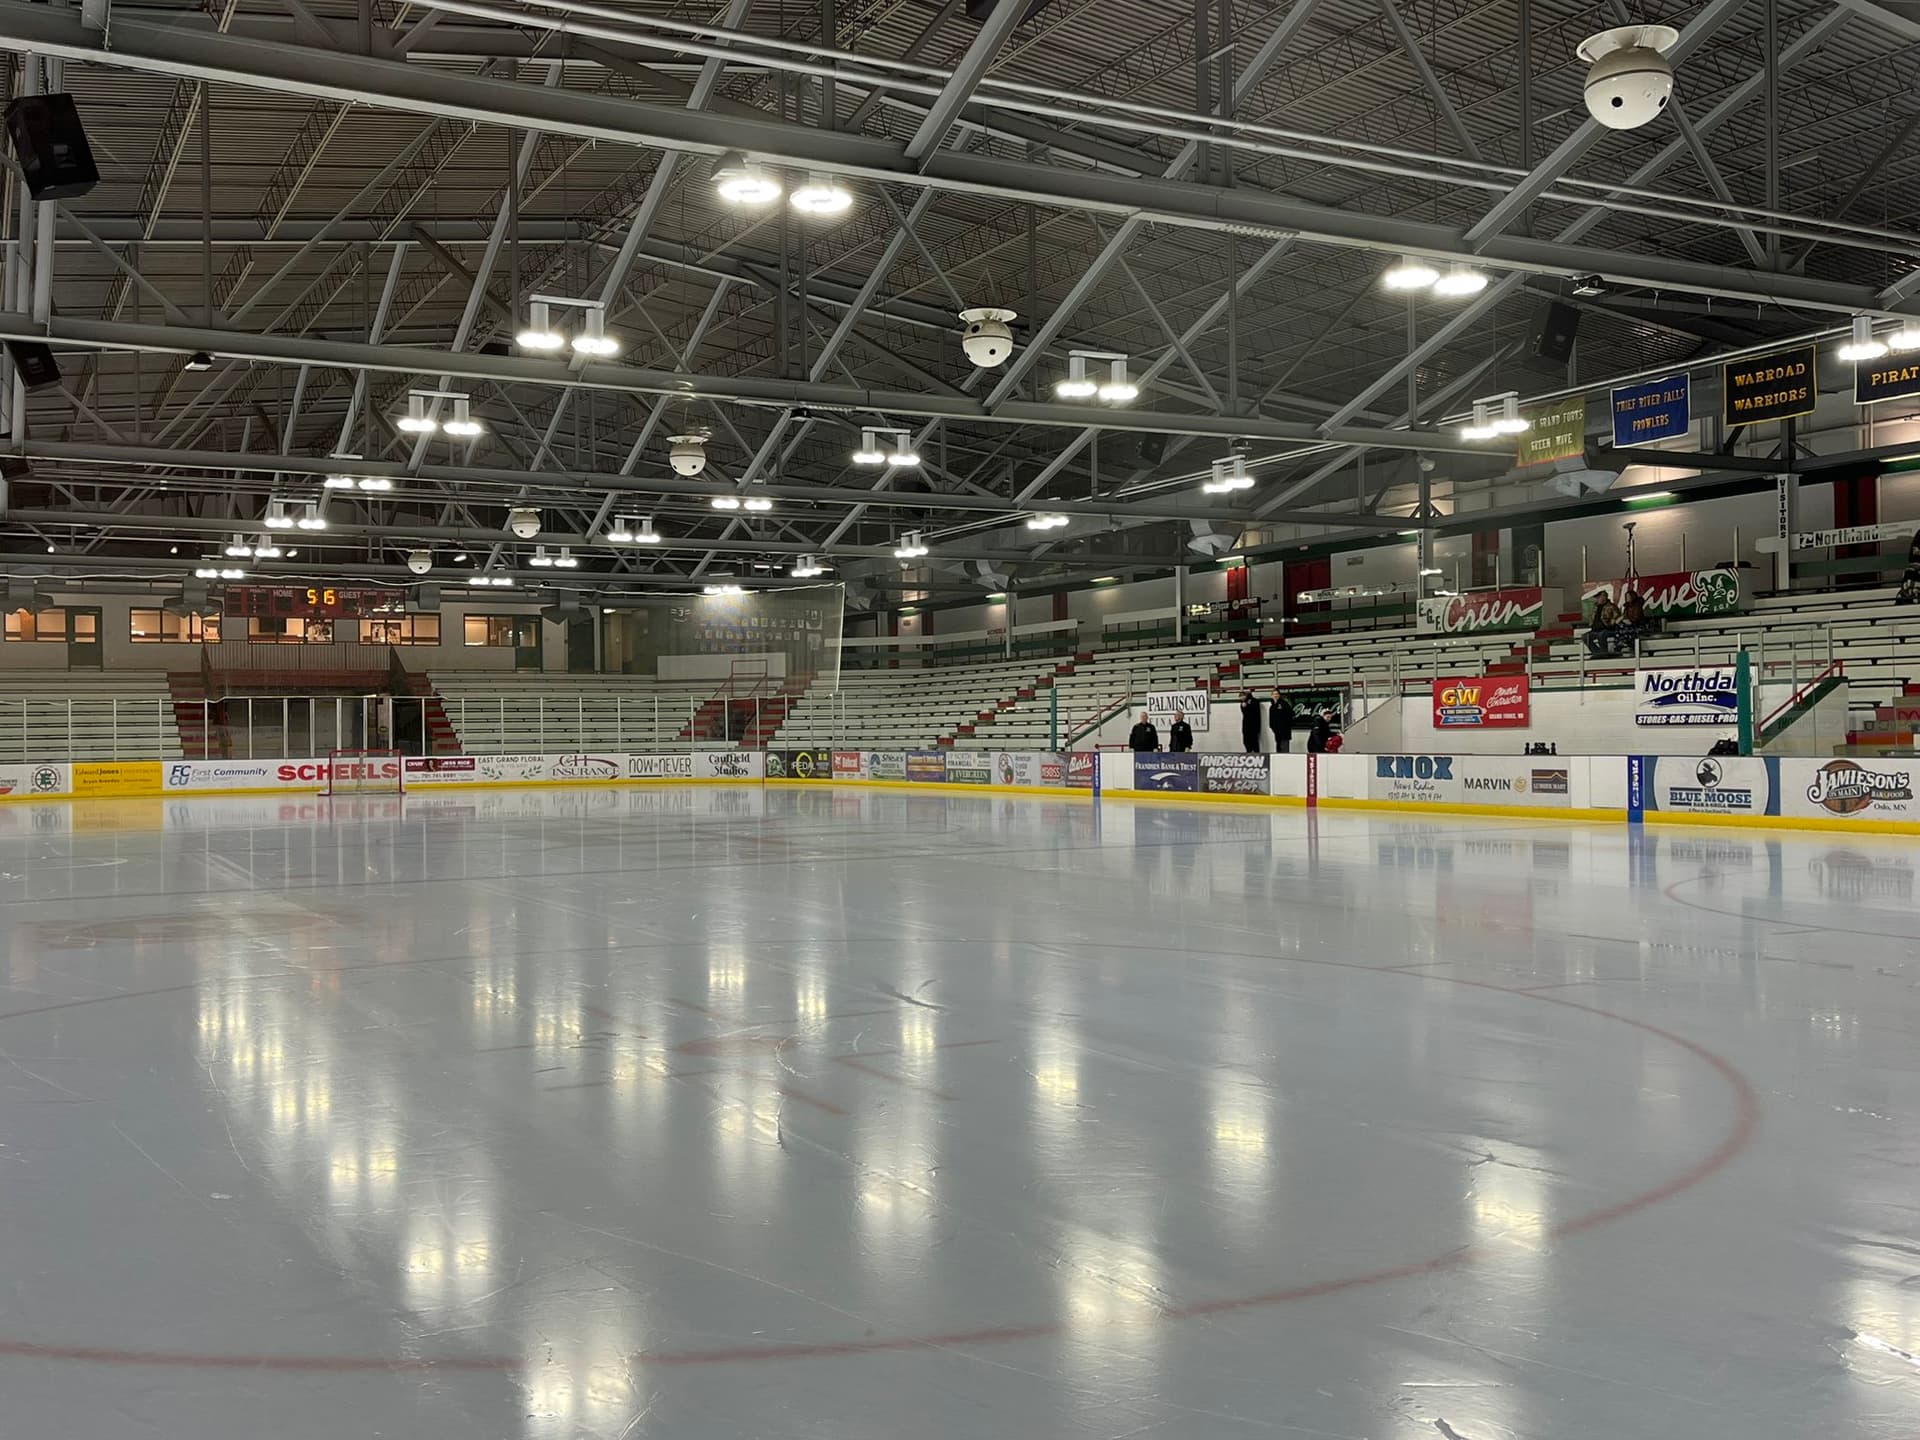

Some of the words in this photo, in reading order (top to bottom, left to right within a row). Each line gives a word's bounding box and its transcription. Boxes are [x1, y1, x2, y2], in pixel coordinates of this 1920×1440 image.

[1734, 363, 1806, 387] WARROAD
[1616, 399, 1636, 412] THIEF
[1638, 394, 1661, 408] RIVER
[1663, 388, 1685, 403] FALLS
[1734, 387, 1807, 411] WARRIORS
[1632, 414, 1669, 431] PROWLERS
[1779, 480, 1787, 539] VISITORS
[272, 590, 293, 598] HOME
[1645, 671, 1738, 692] Northdal
[1440, 687, 1481, 706] GW
[1677, 693, 1694, 703] Oil
[1696, 692, 1717, 703] Inc.
[521, 755, 544, 763] FLORAL
[1200, 755, 1265, 767] ANDERSON
[172, 765, 191, 777] FC
[214, 768, 267, 777] Community
[278, 763, 398, 781] SCHEELS
[552, 768, 618, 776] INSURANCE
[1207, 767, 1268, 779] BROTHERS
[1376, 756, 1453, 779] KNOX
[169, 776, 188, 786] CU
[1413, 779, 1435, 791] Radio
[1464, 778, 1511, 790] MARVIN
[1808, 769, 1908, 803] JAMIESON'S
[1670, 791, 1701, 801] BLUE
[1704, 793, 1751, 804] MOOSE
[1839, 788, 1858, 797] MAIN
